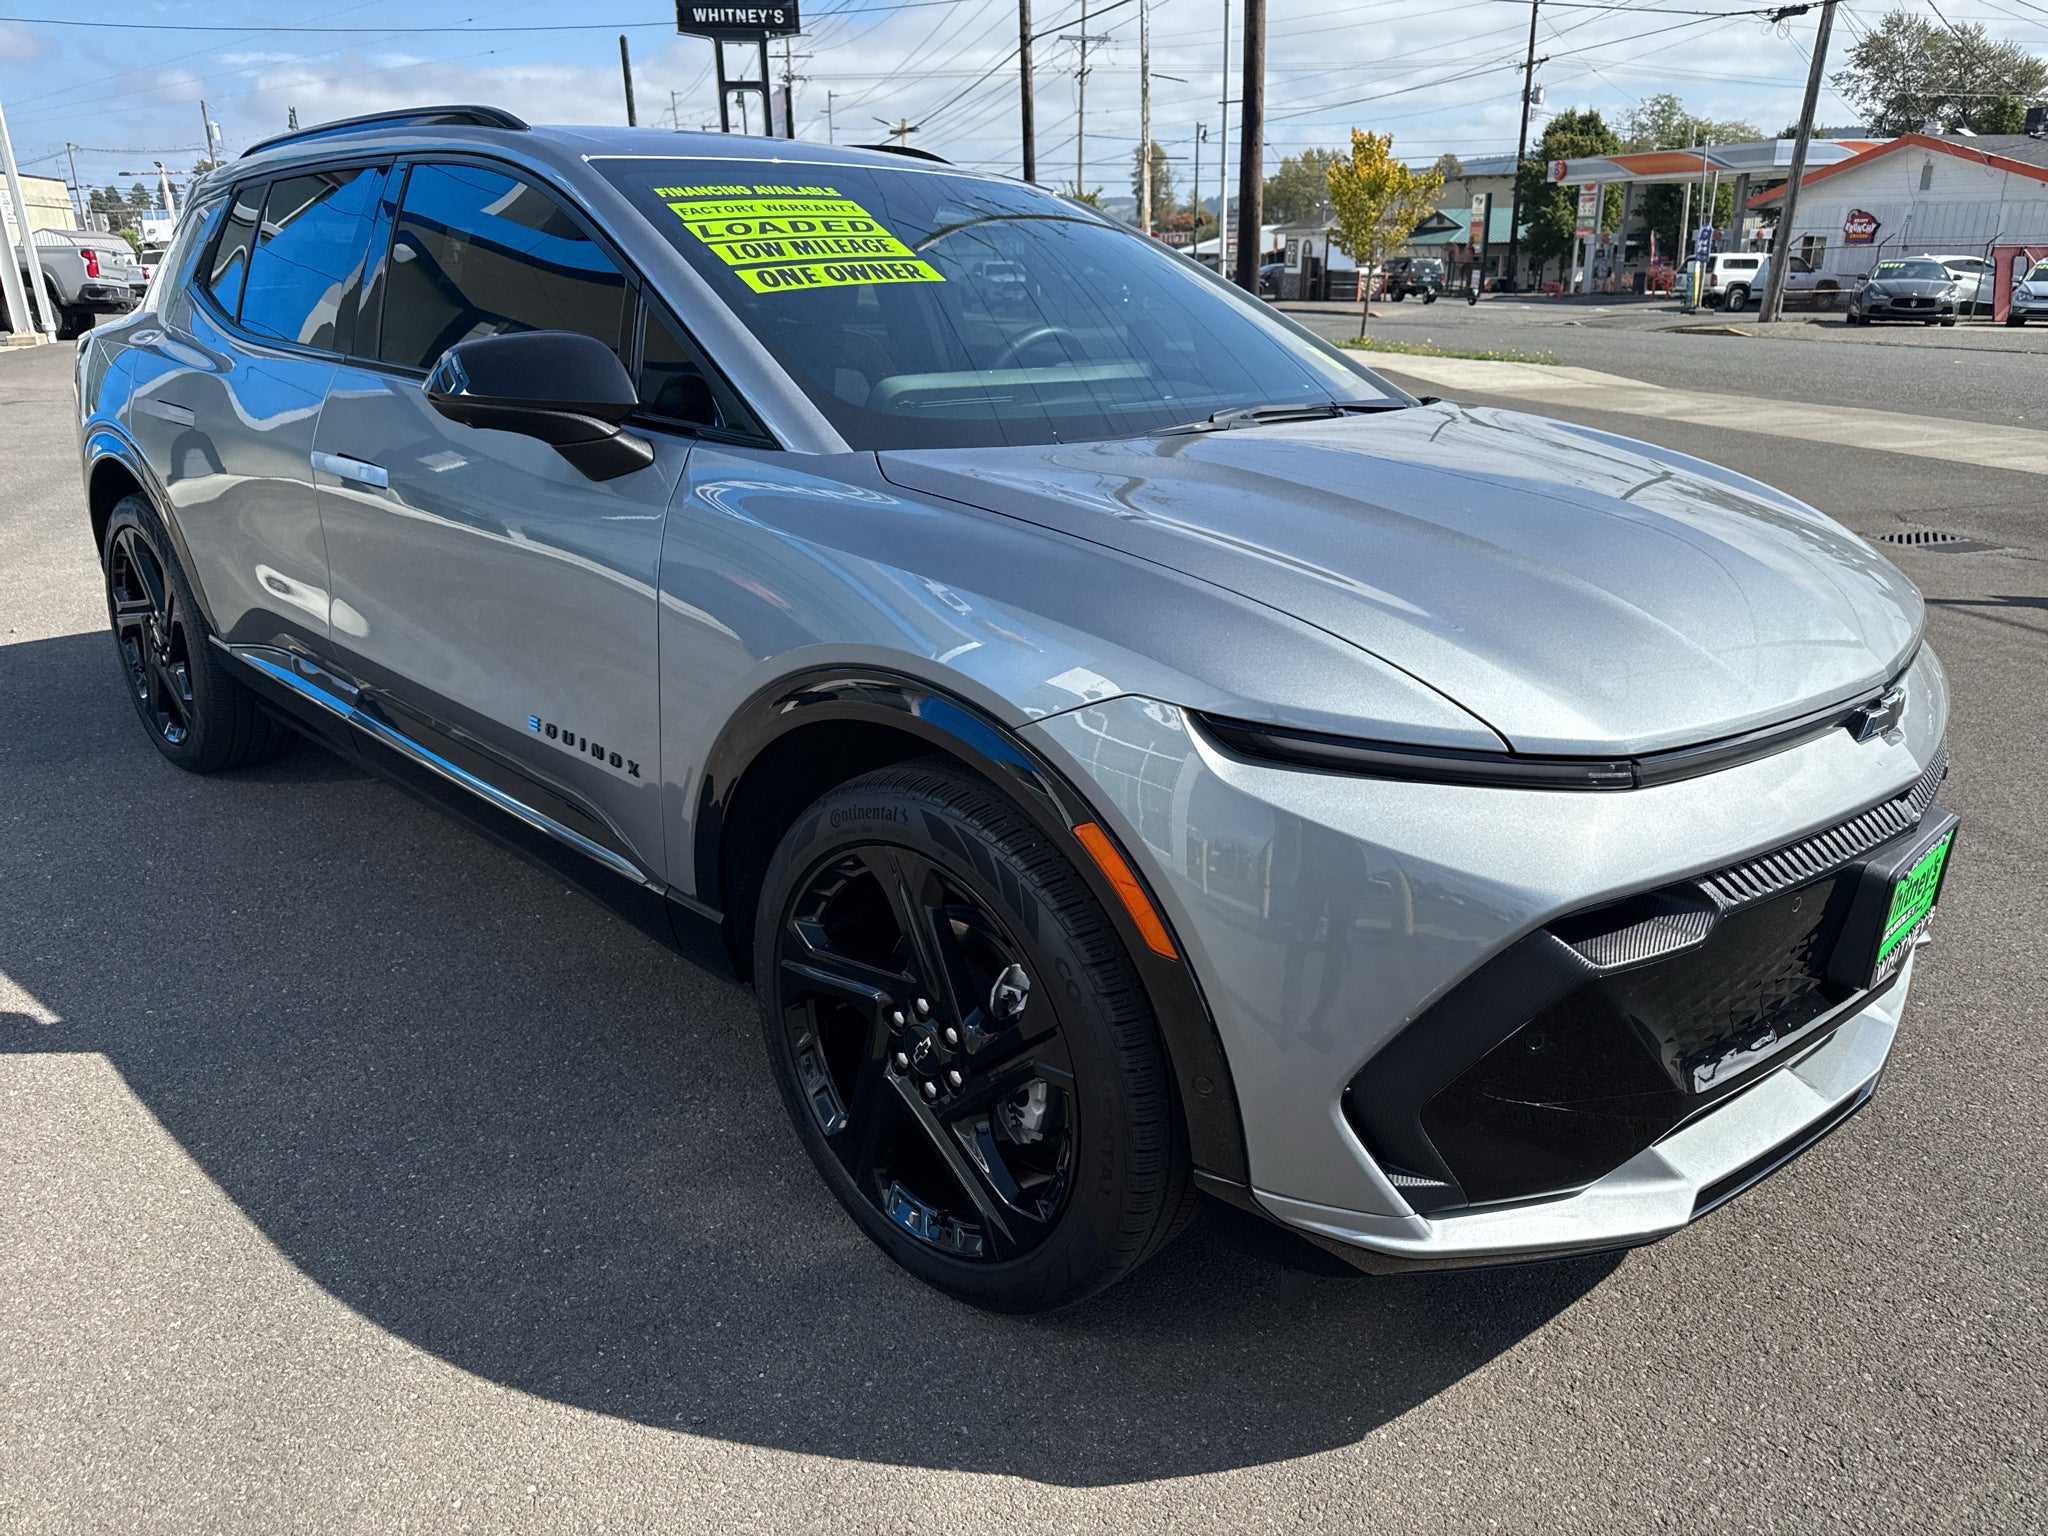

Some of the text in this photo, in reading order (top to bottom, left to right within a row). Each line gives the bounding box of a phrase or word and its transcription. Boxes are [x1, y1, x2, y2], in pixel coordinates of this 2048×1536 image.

[692, 7, 785, 24] WHITNEY'S
[653, 185, 842, 198] FINANCING AVAILABLE
[678, 203, 859, 216] FACTORY WARRANTY
[697, 220, 875, 239] LOADED
[1845, 222, 1877, 234] KRUNCHY
[725, 238, 896, 261] LOW MILEAGE
[756, 262, 927, 289] ONE OWNER
[527, 714, 641, 778] EQUINOX
[829, 804, 898, 828] Continental
